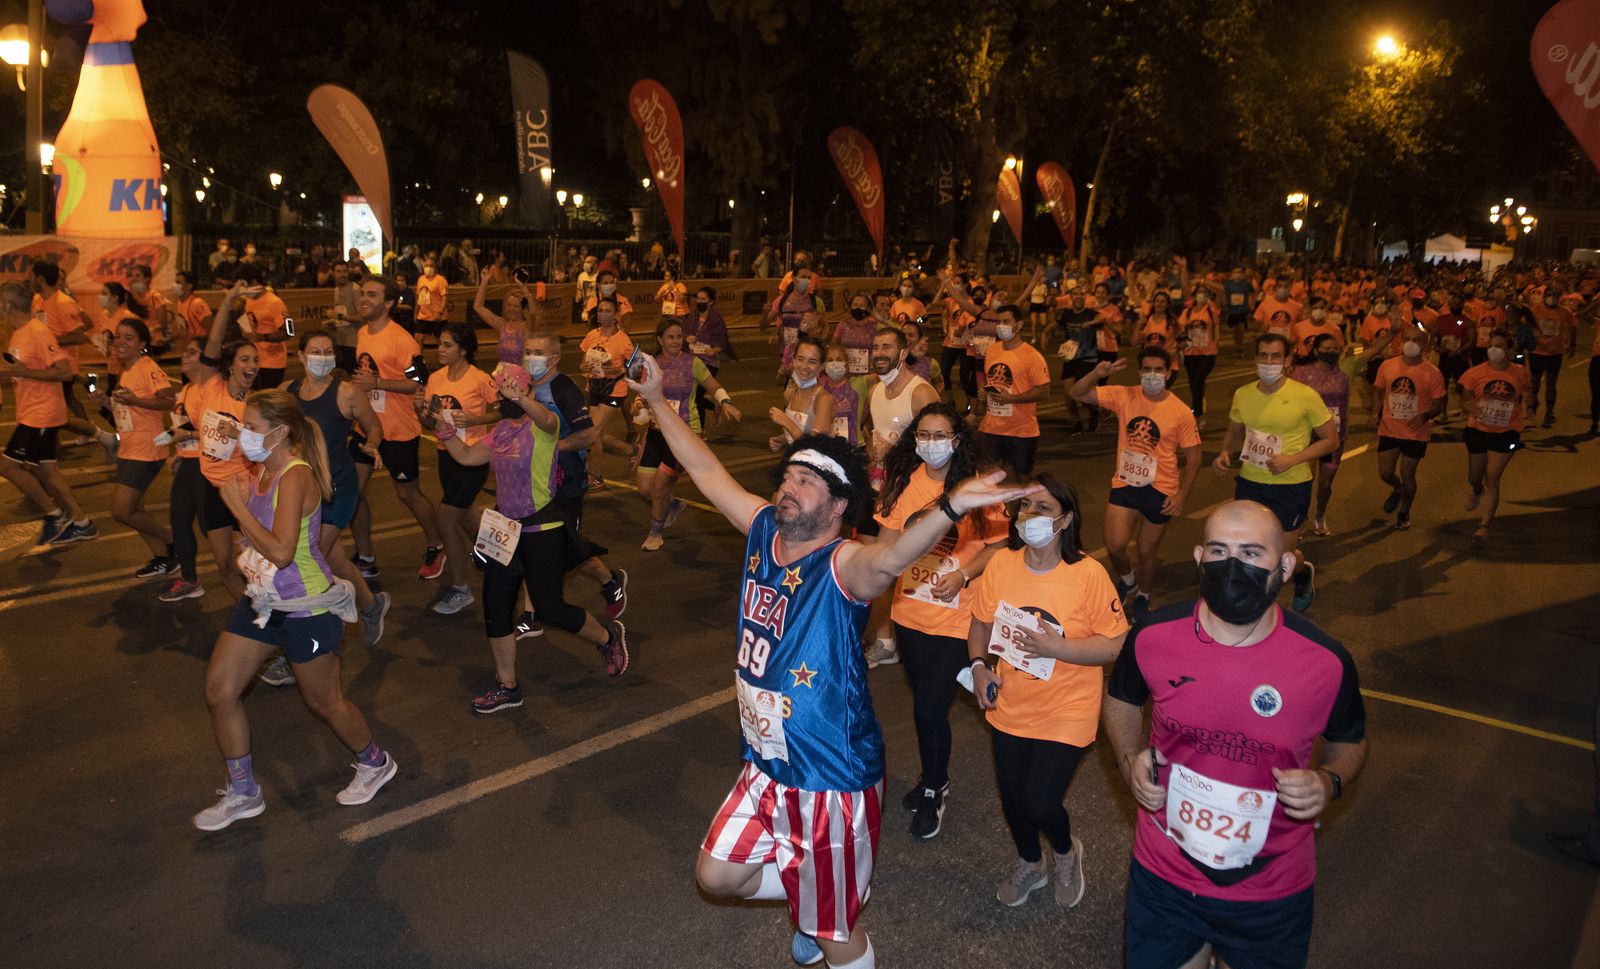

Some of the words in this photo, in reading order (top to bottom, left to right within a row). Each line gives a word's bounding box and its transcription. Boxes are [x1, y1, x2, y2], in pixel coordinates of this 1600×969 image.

[1123, 461, 1149, 477] 8830
[489, 527, 510, 547] 762
[911, 566, 939, 587] 920
[743, 579, 789, 641] NBA
[738, 628, 771, 679] 69
[1167, 717, 1276, 755] Deportes
[1178, 800, 1252, 844] 8824
